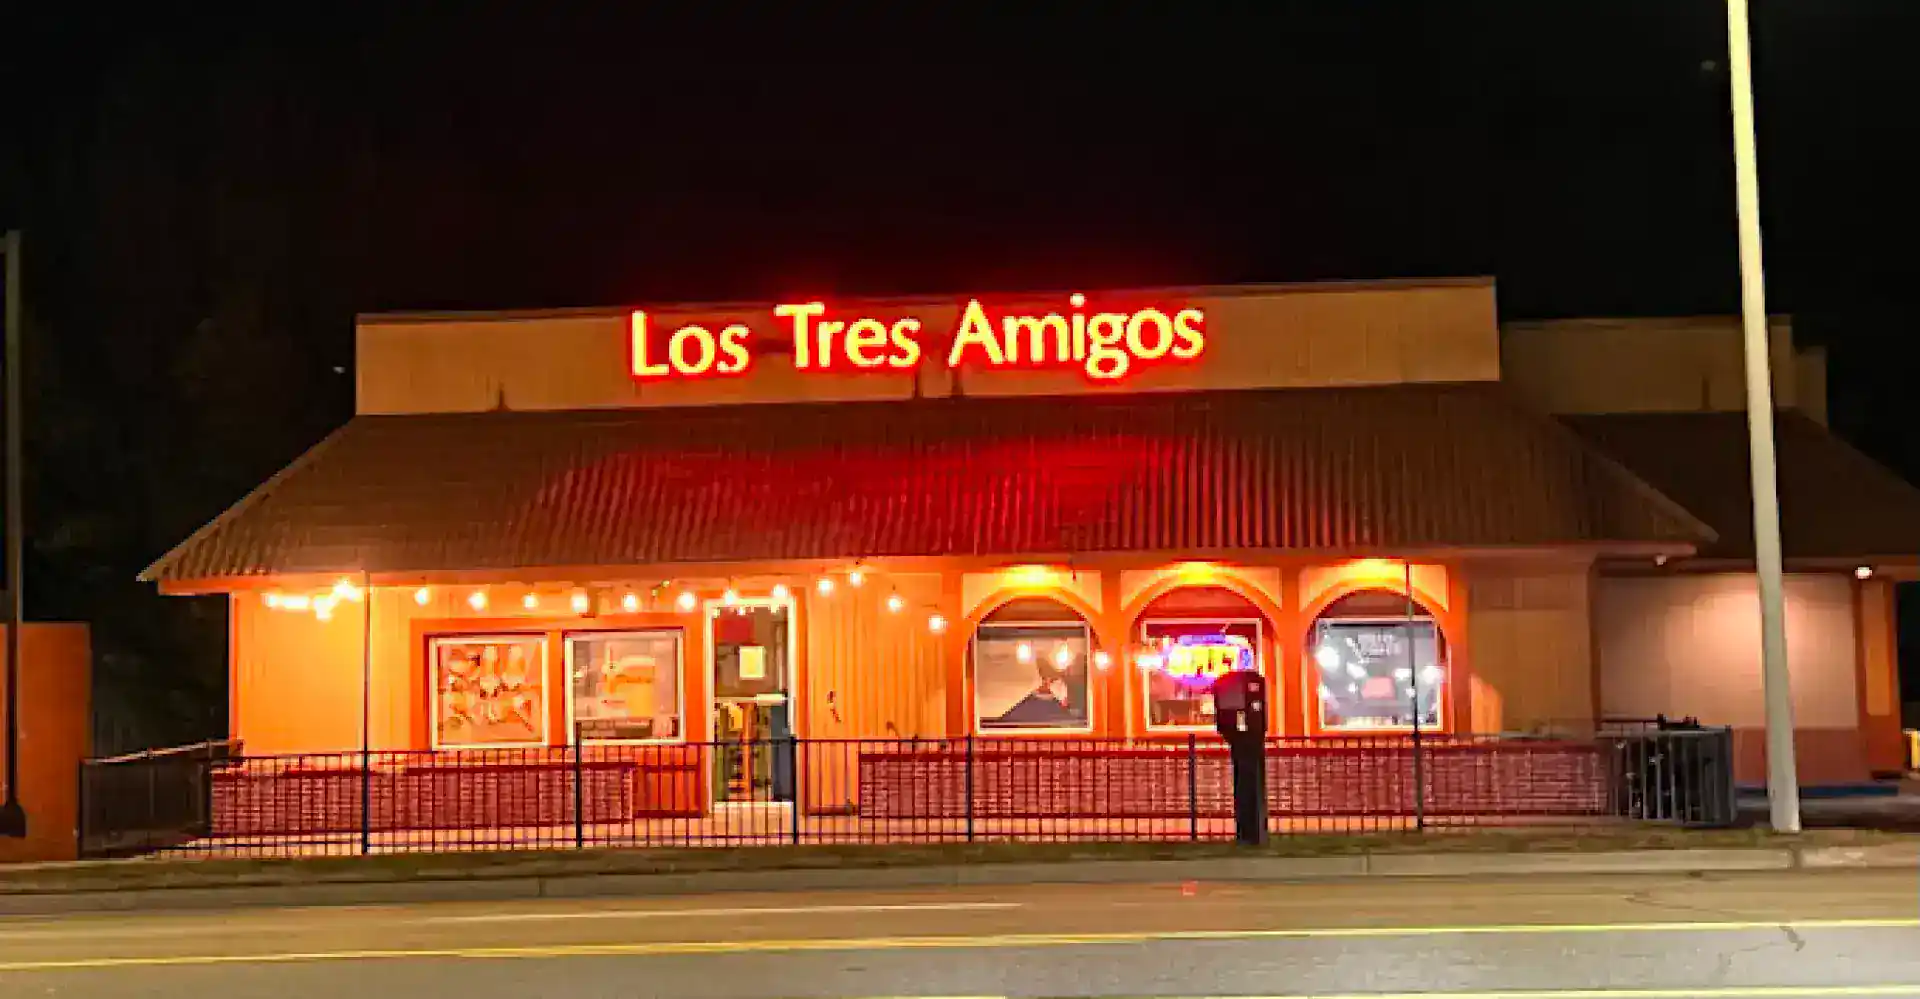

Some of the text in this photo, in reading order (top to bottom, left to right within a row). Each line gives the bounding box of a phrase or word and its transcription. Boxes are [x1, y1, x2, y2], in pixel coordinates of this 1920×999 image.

[631, 293, 1205, 379] Los Tres Amigos
